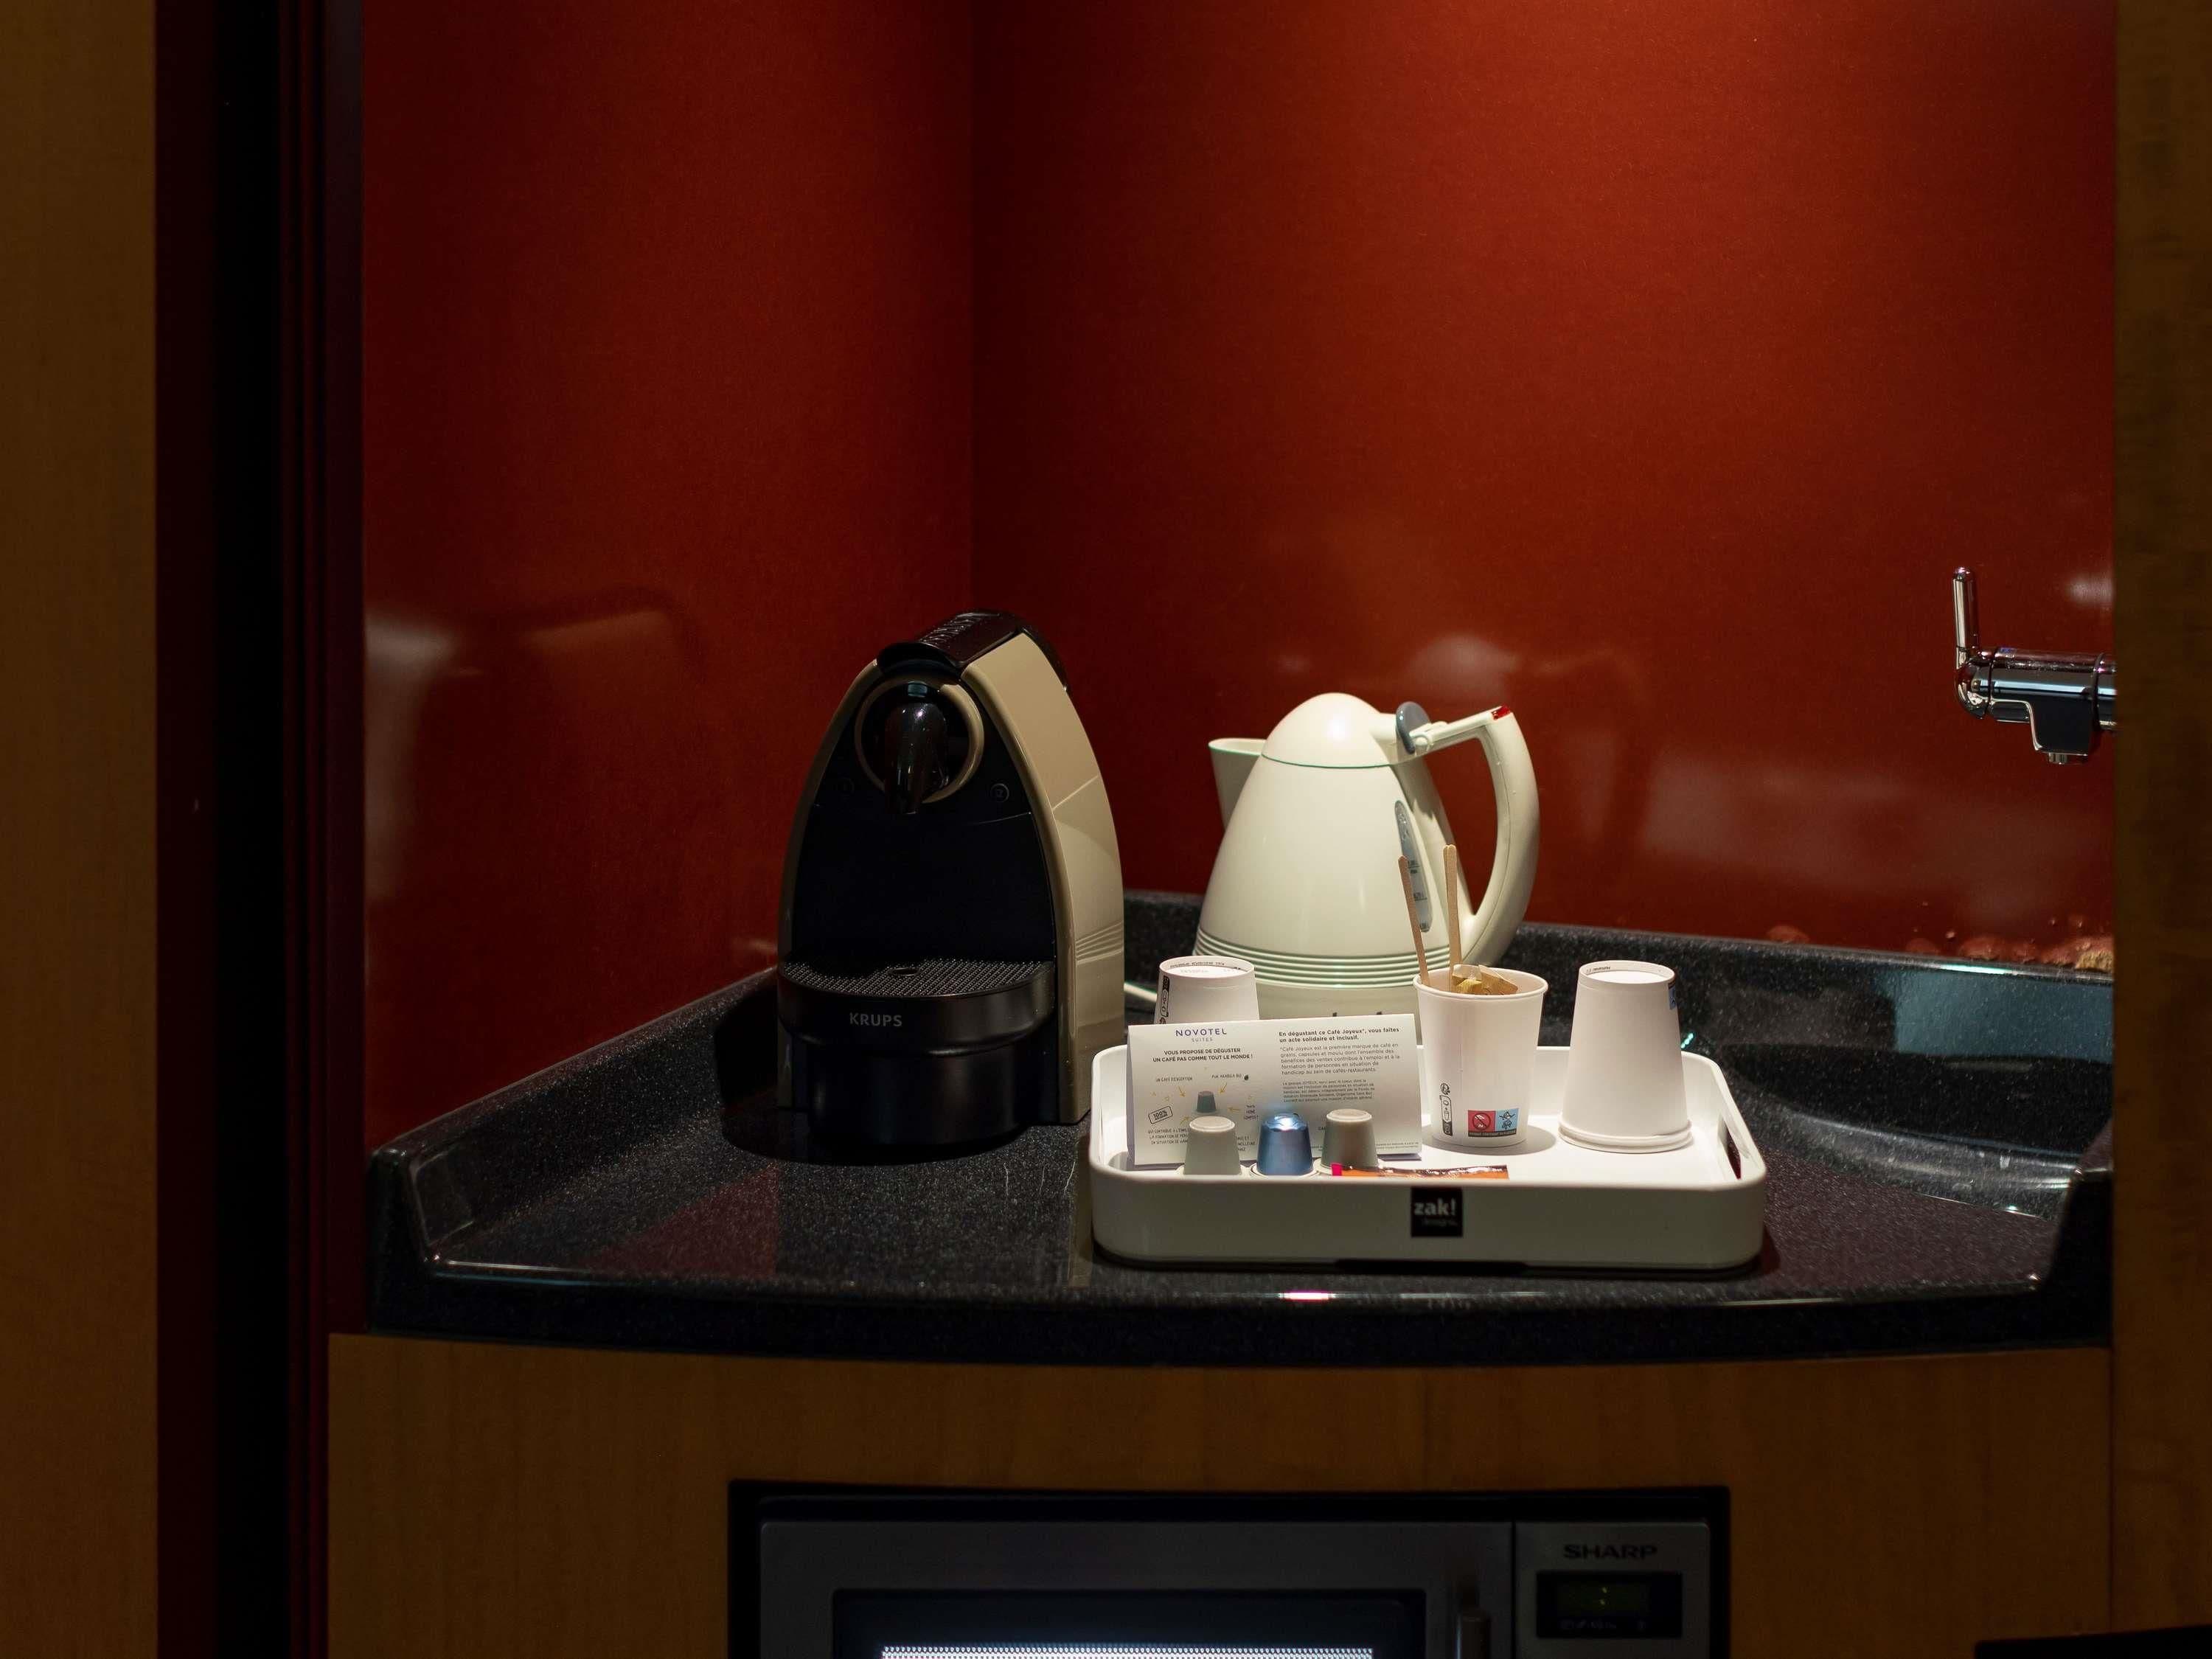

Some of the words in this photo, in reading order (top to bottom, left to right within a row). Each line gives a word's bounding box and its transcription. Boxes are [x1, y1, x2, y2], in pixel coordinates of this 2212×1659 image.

[849, 1012, 903, 1027] KRUPS
[1175, 1028, 1227, 1037] NOVOTEL
[1287, 1029, 1318, 1037] dégustant
[1153, 1110, 1167, 1118] 100%
[1413, 1197, 1455, 1215] zak!
[1563, 1544, 1658, 1559] SHARP
